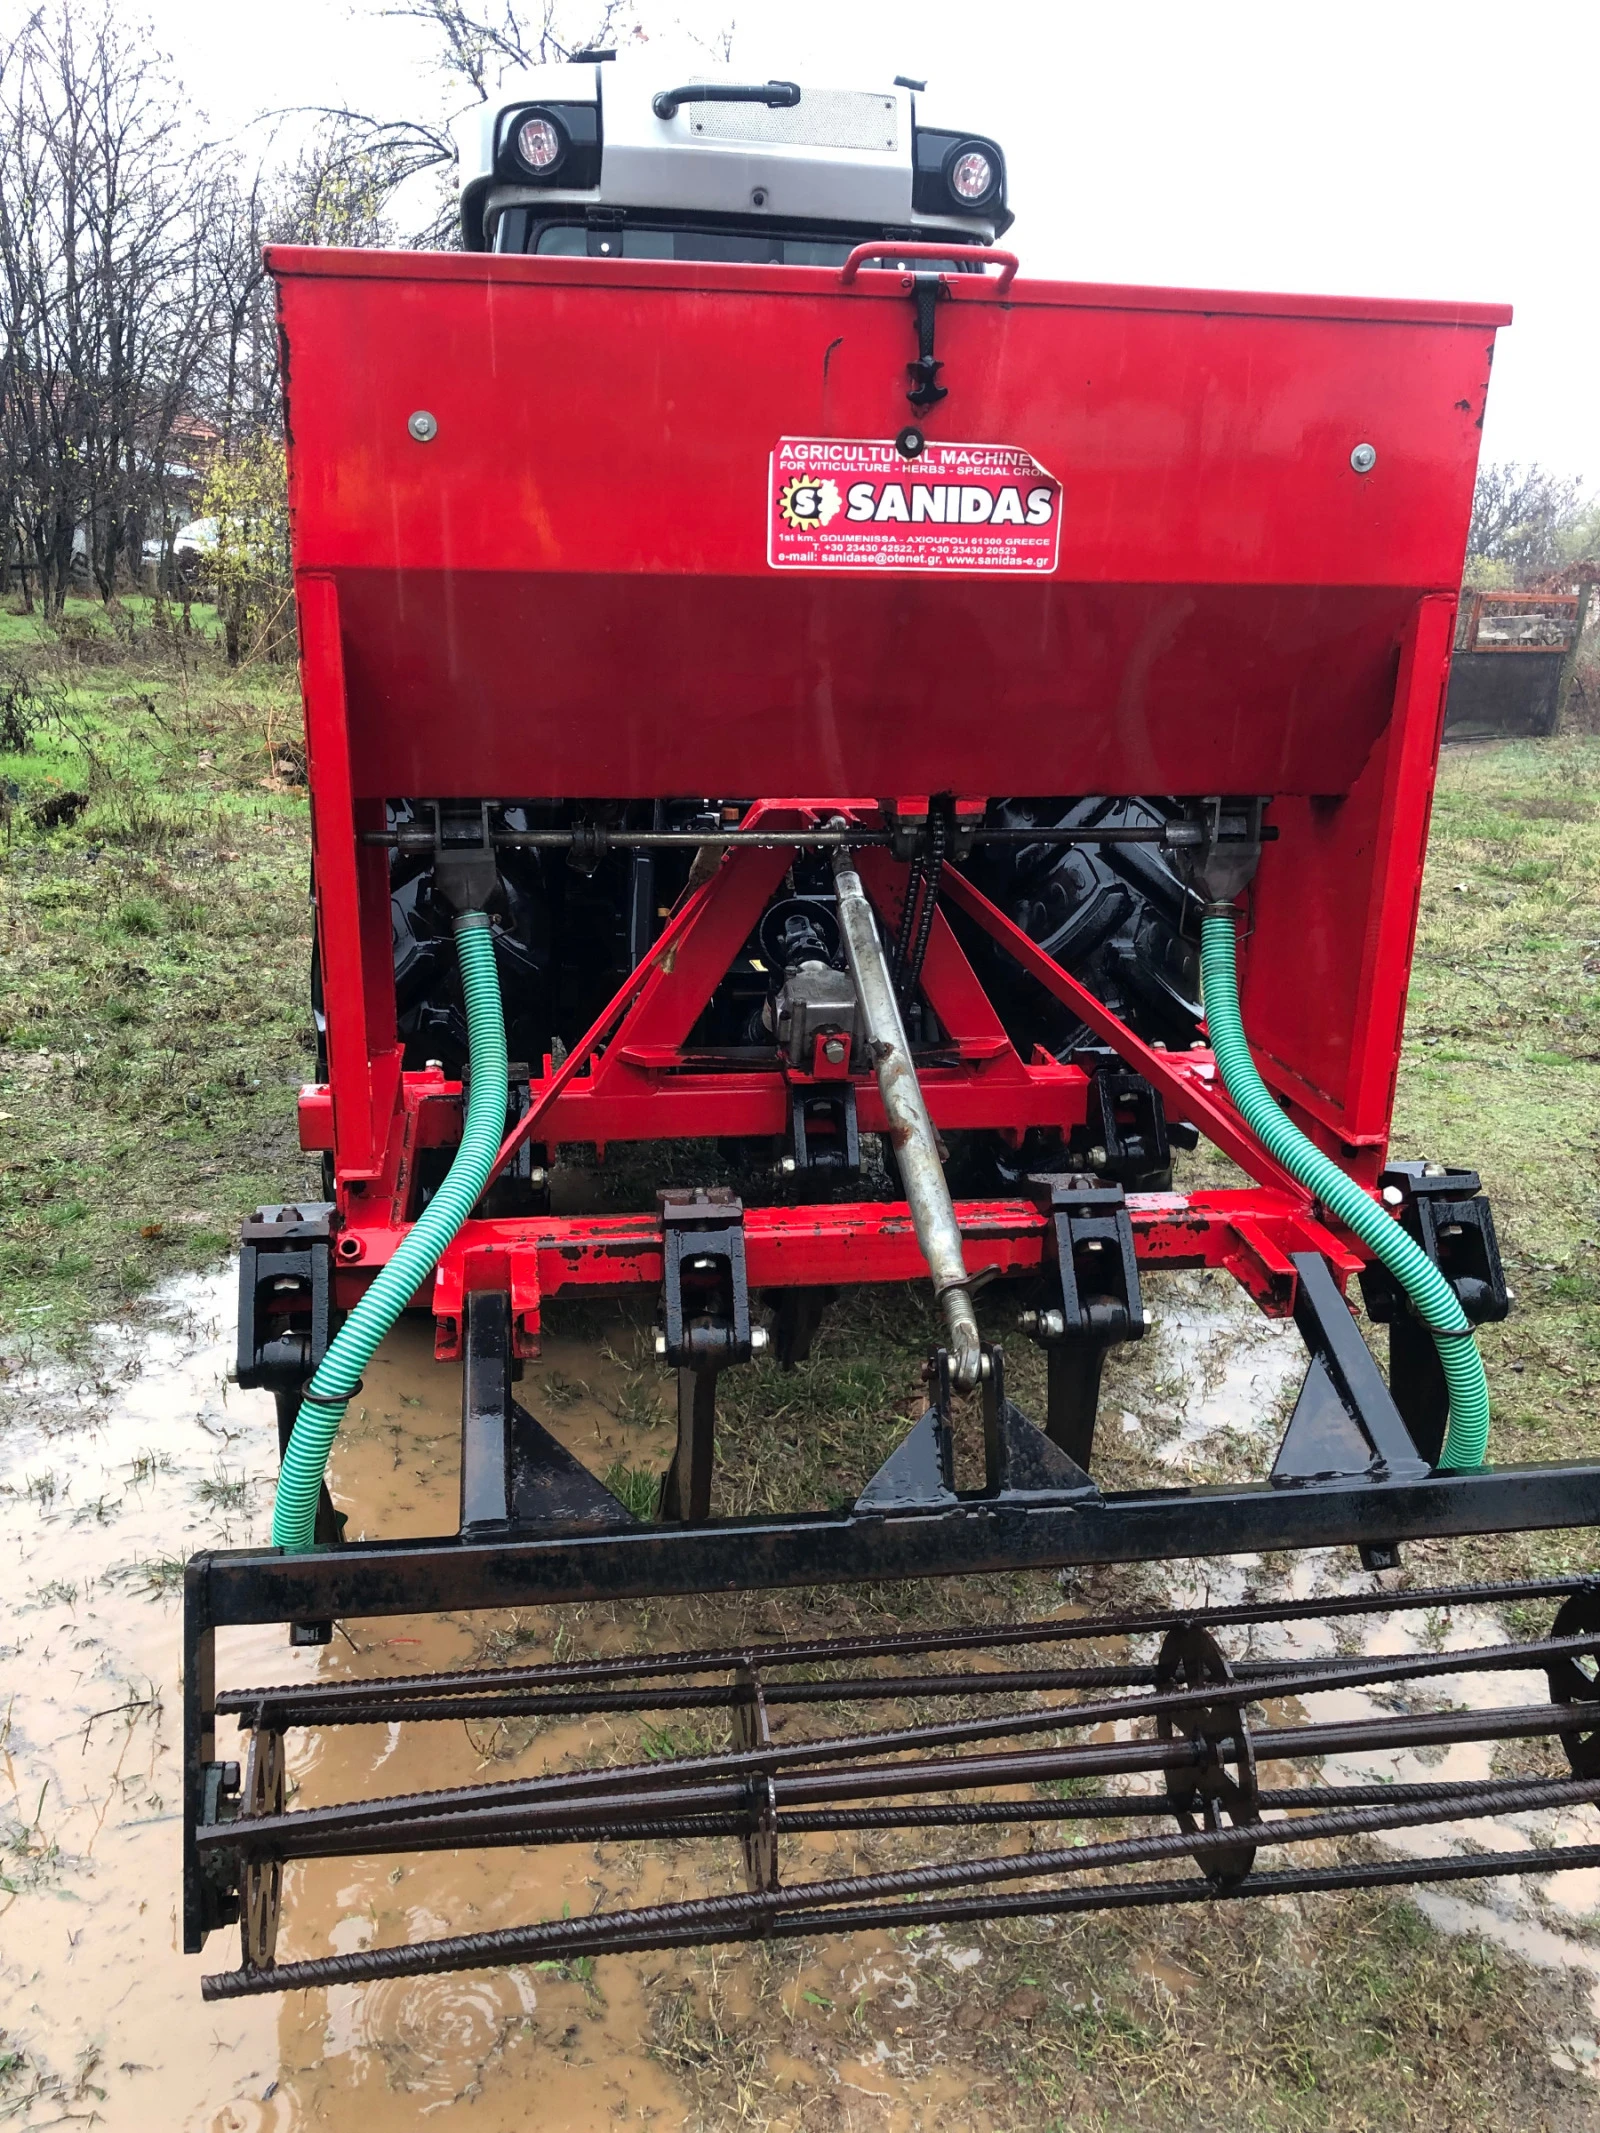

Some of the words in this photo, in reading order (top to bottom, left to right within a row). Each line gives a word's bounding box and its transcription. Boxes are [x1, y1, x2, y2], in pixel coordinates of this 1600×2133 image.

[941, 449, 1035, 467] MACHINE
[779, 461, 806, 470] FOR
[809, 462, 891, 472] VITICULTURE
[902, 464, 946, 474] HERBS
[956, 466, 1010, 476] SPECIAL
[847, 482, 1053, 525] SANIDAS
[778, 533, 796, 542] 1st
[797, 533, 817, 542] km.
[819, 534, 897, 543] GOUMENISSA
[906, 535, 968, 545] AXIOUPOLI
[971, 537, 1002, 545] 61300
[1005, 538, 1050, 546] GREECE
[812, 543, 821, 551] T.
[824, 543, 843, 552] +30
[846, 544, 878, 552] 23430
[880, 544, 915, 554] 42522,
[918, 545, 927, 553] F.
[930, 545, 949, 554] +30
[952, 545, 983, 554] 23430
[986, 547, 1017, 555] 20523
[778, 551, 818, 562] e-mail:
[946, 554, 1049, 568] www.sanidas-e.gr
